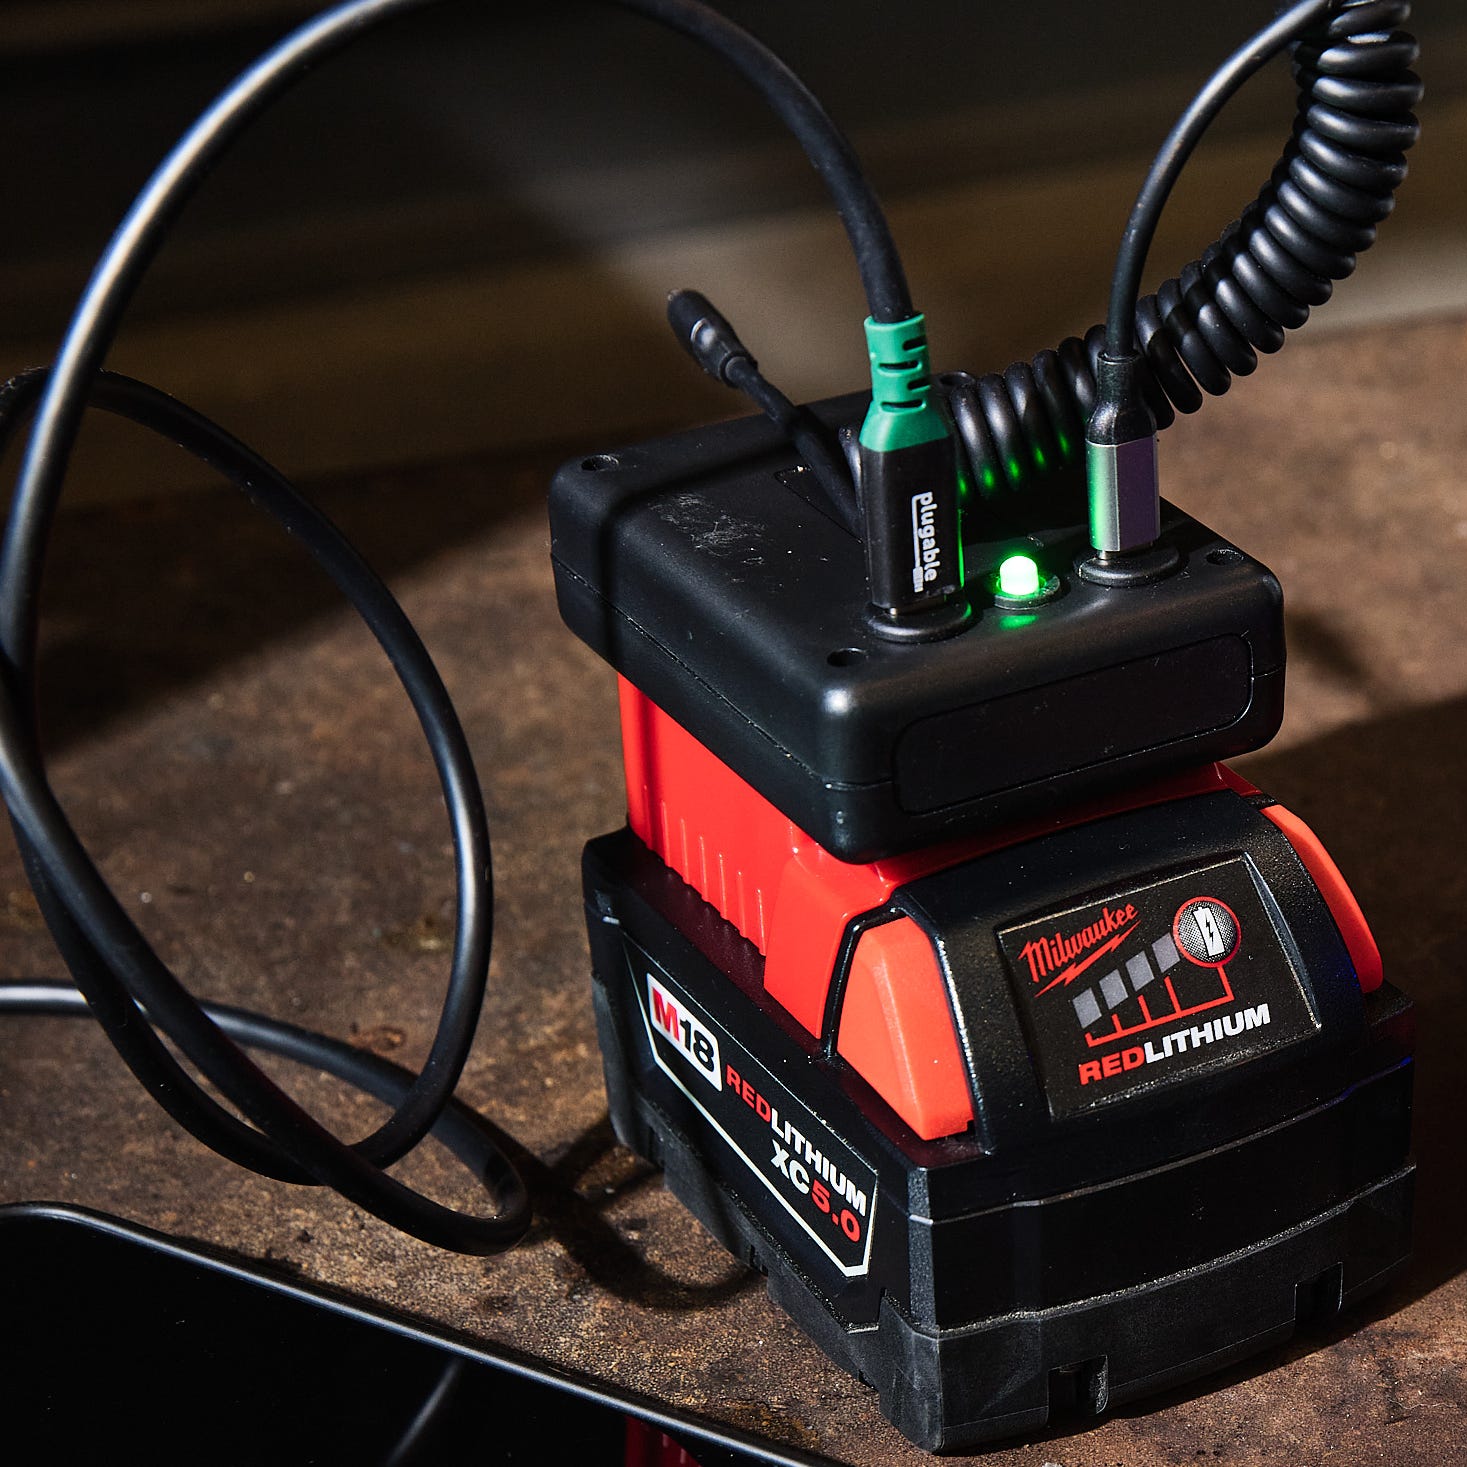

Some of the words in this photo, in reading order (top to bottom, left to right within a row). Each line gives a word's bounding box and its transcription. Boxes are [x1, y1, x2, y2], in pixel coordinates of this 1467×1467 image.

[912, 491, 941, 582] plugable
[1017, 903, 1138, 983] Milwaukee
[1078, 1003, 1271, 1086] REDLITHIUM
[652, 986, 715, 1073] M18
[726, 1063, 867, 1217] REDLITHIUM
